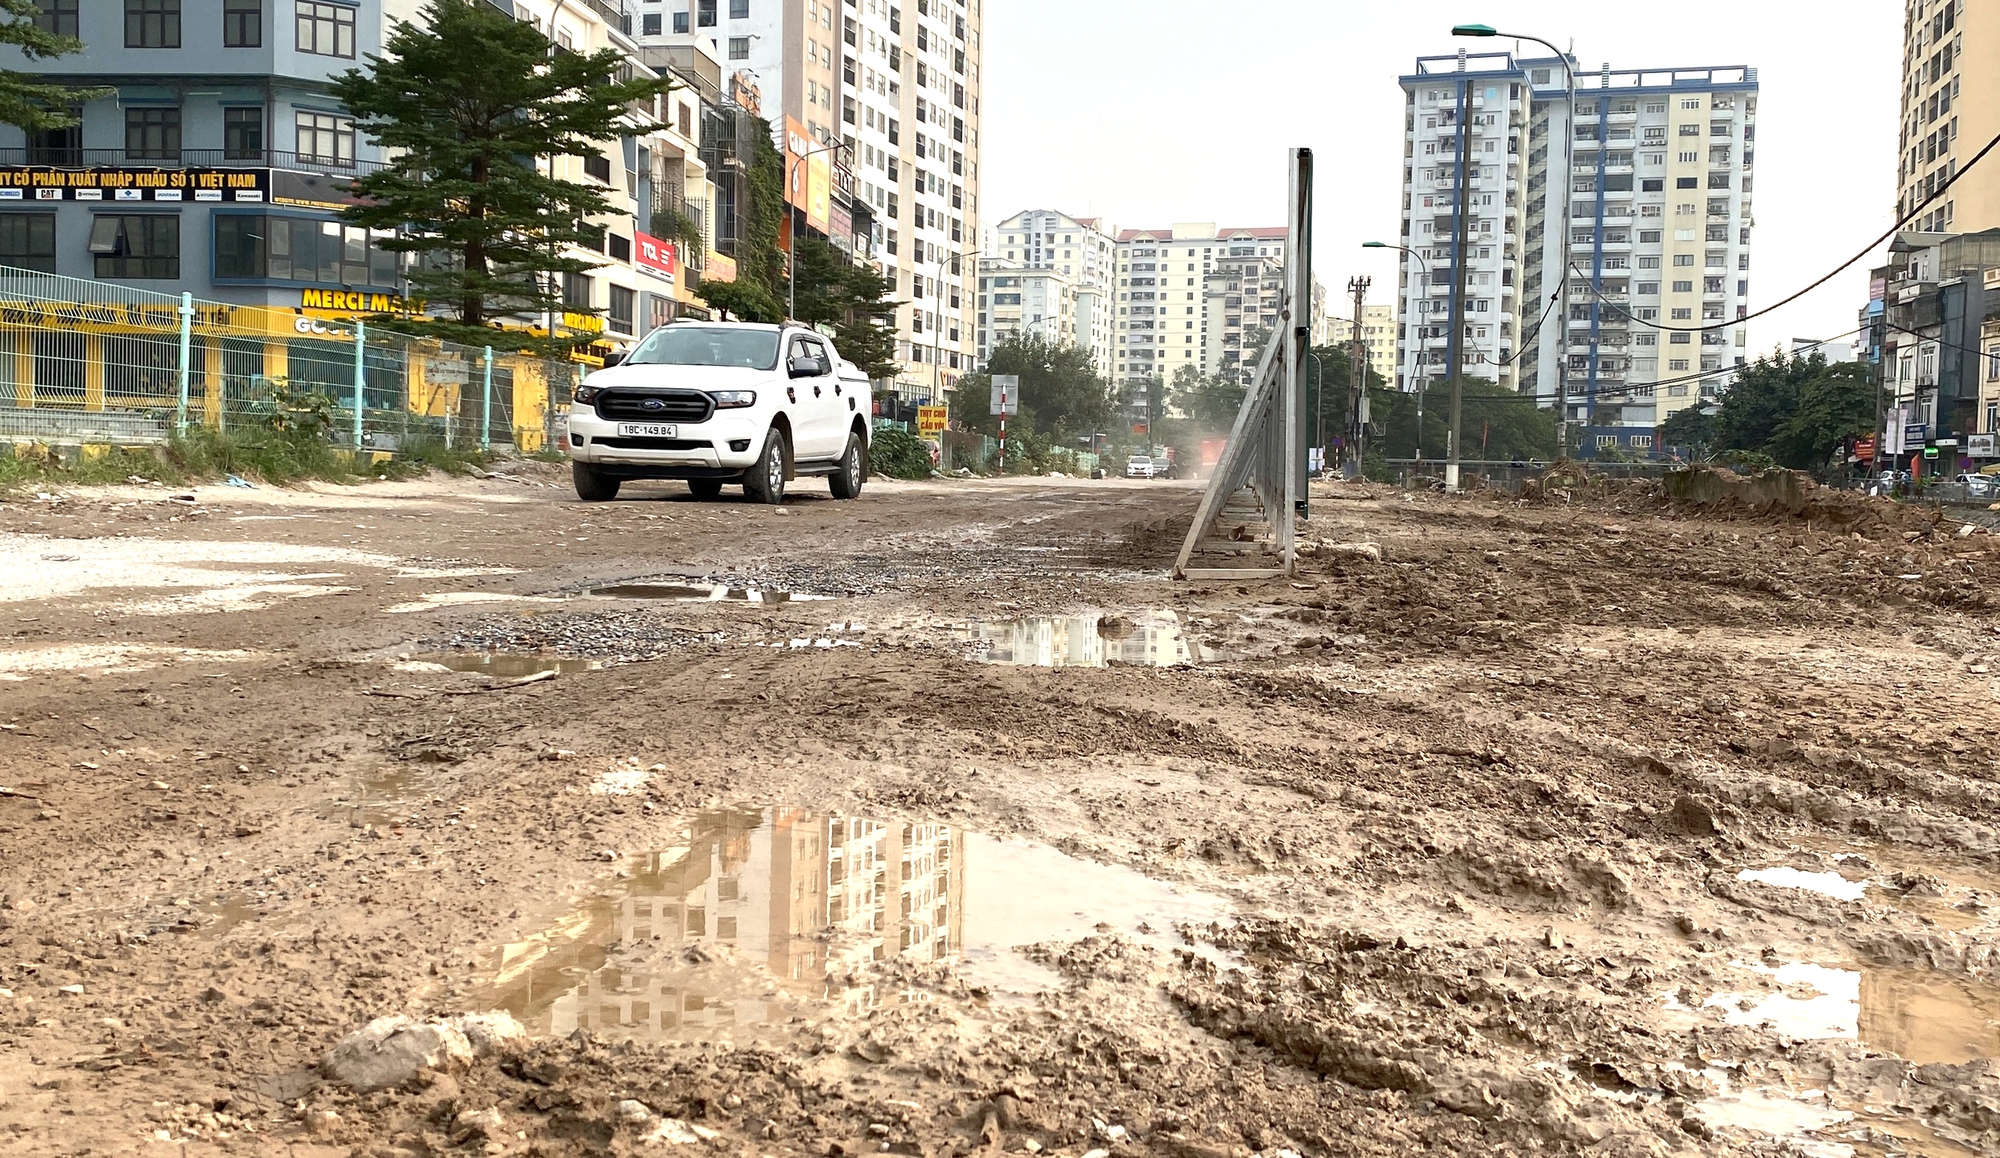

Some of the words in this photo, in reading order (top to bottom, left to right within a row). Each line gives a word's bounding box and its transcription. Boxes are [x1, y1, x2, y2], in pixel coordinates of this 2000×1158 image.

[14, 168, 30, 186] CỔ
[33, 167, 65, 186] PHẦN
[67, 168, 98, 187] XUẤT
[100, 170, 133, 189] NHẬP
[135, 168, 167, 187] KHẨU
[170, 168, 187, 187] SỐ
[189, 174, 195, 187] 1
[199, 171, 225, 189] VIỆT
[228, 174, 256, 188] NAM
[41, 189, 55, 199] CAT
[641, 241, 659, 262] TCL
[302, 288, 364, 311] MERCI
[624, 425, 672, 435] 18C-149.84
